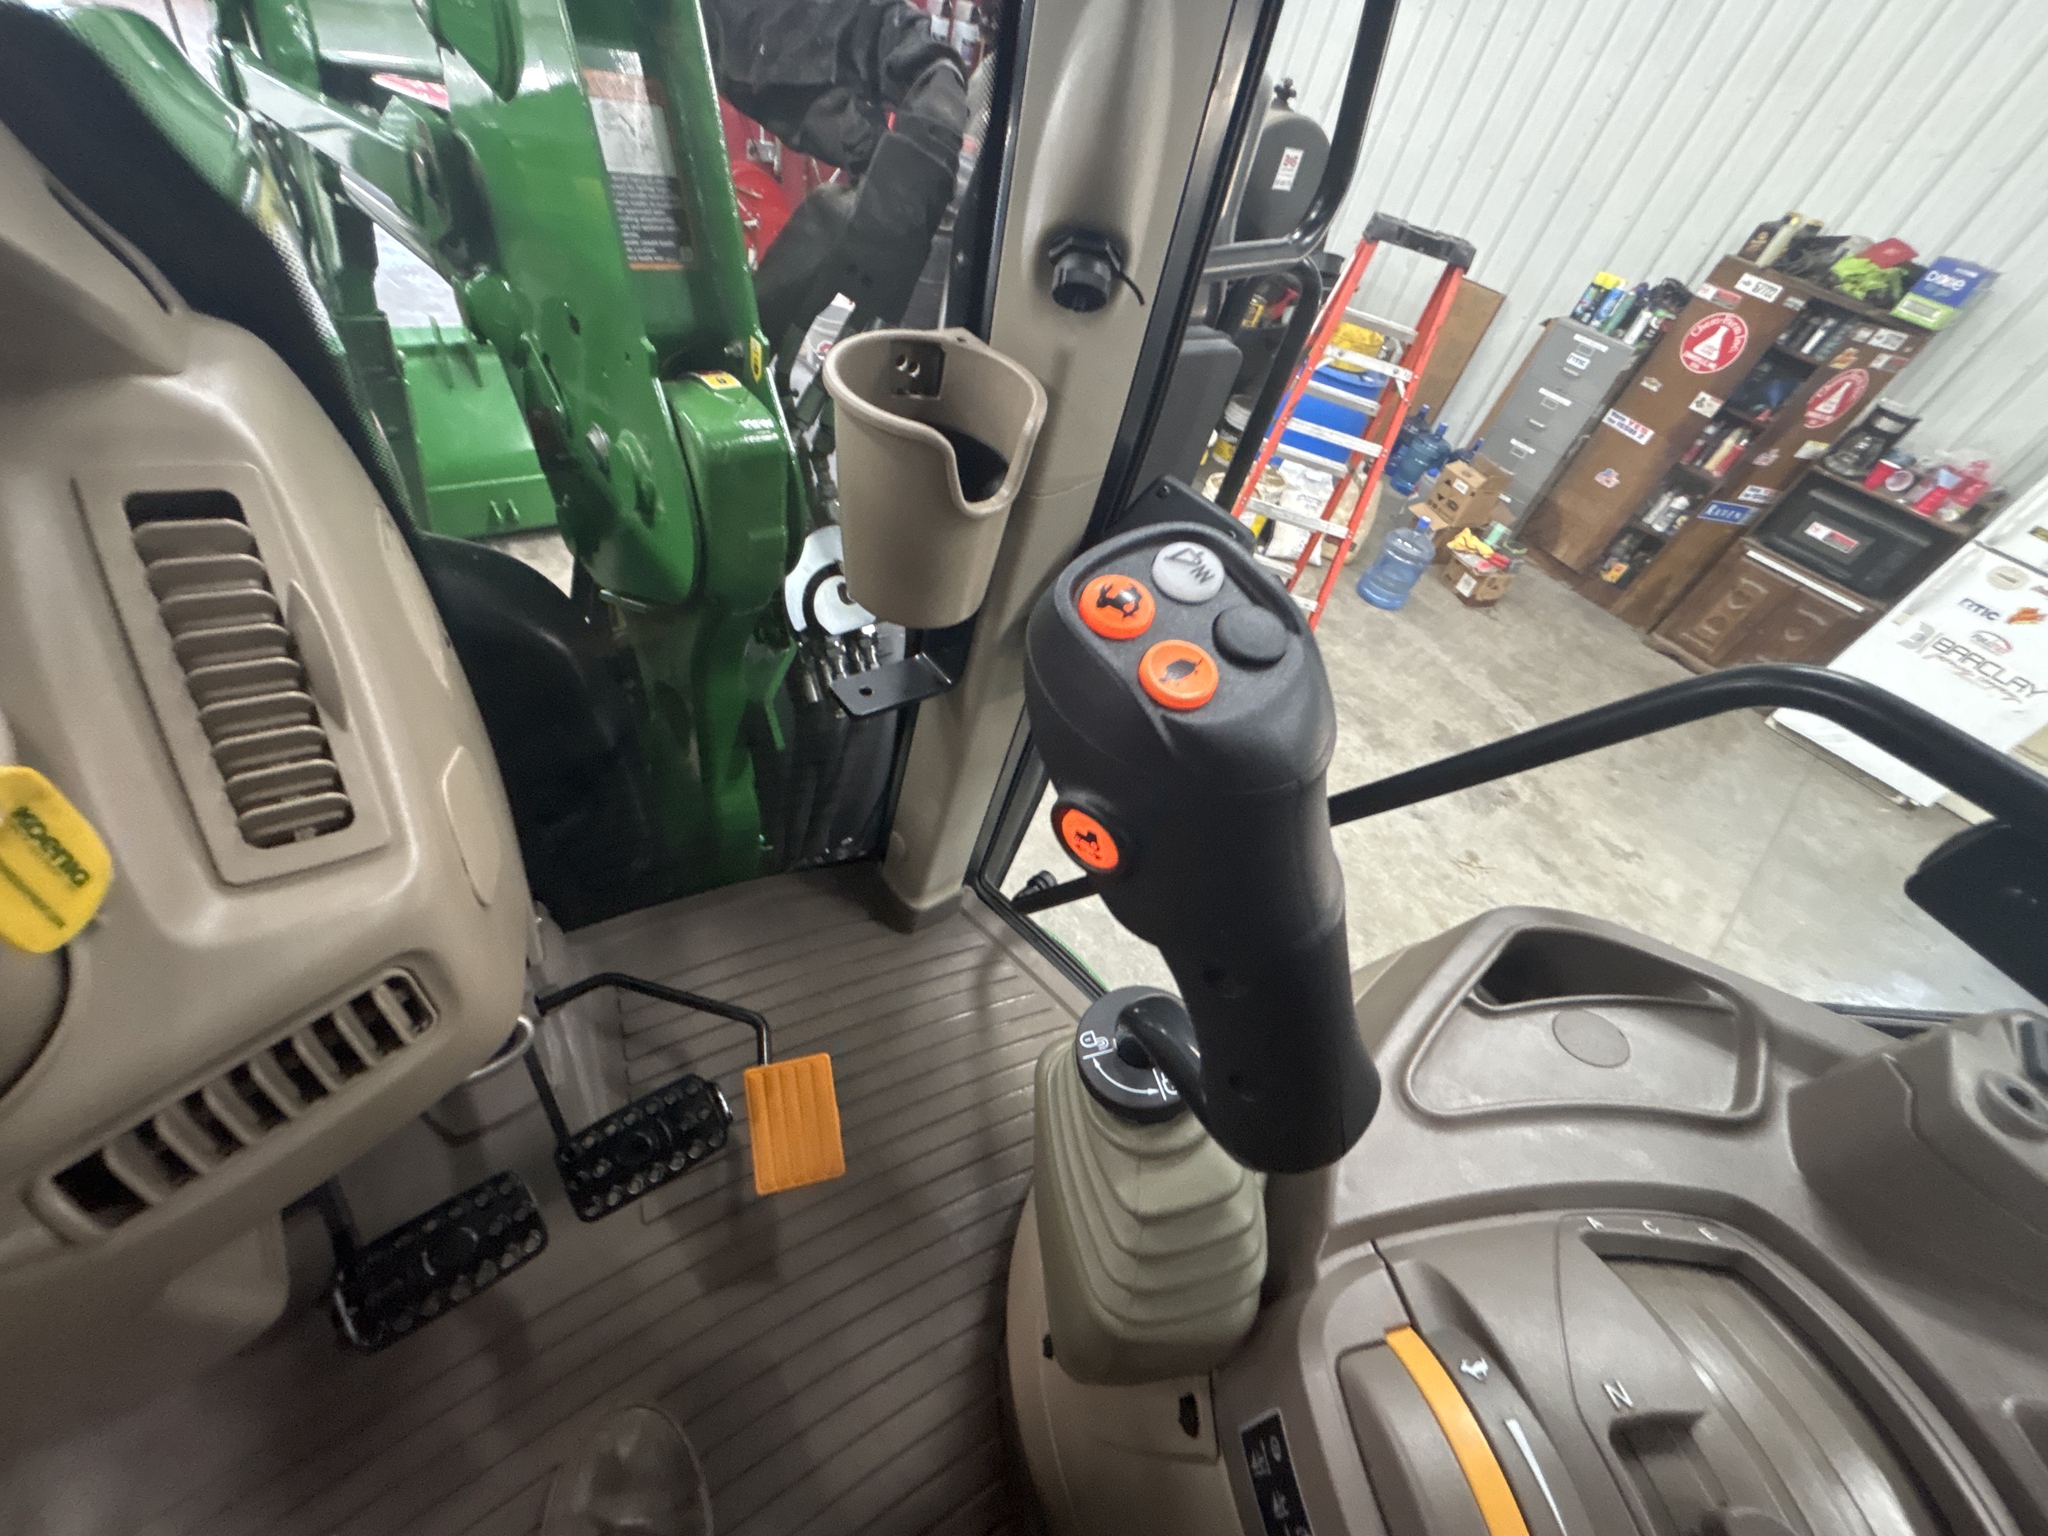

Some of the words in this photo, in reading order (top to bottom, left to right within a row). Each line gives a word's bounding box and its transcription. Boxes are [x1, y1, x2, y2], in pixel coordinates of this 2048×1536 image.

[1628, 419, 1649, 434] YES
[1932, 637, 2048, 698] BARCLAY
[1641, 1220, 1661, 1235] C
[1602, 1380, 1634, 1409] N
